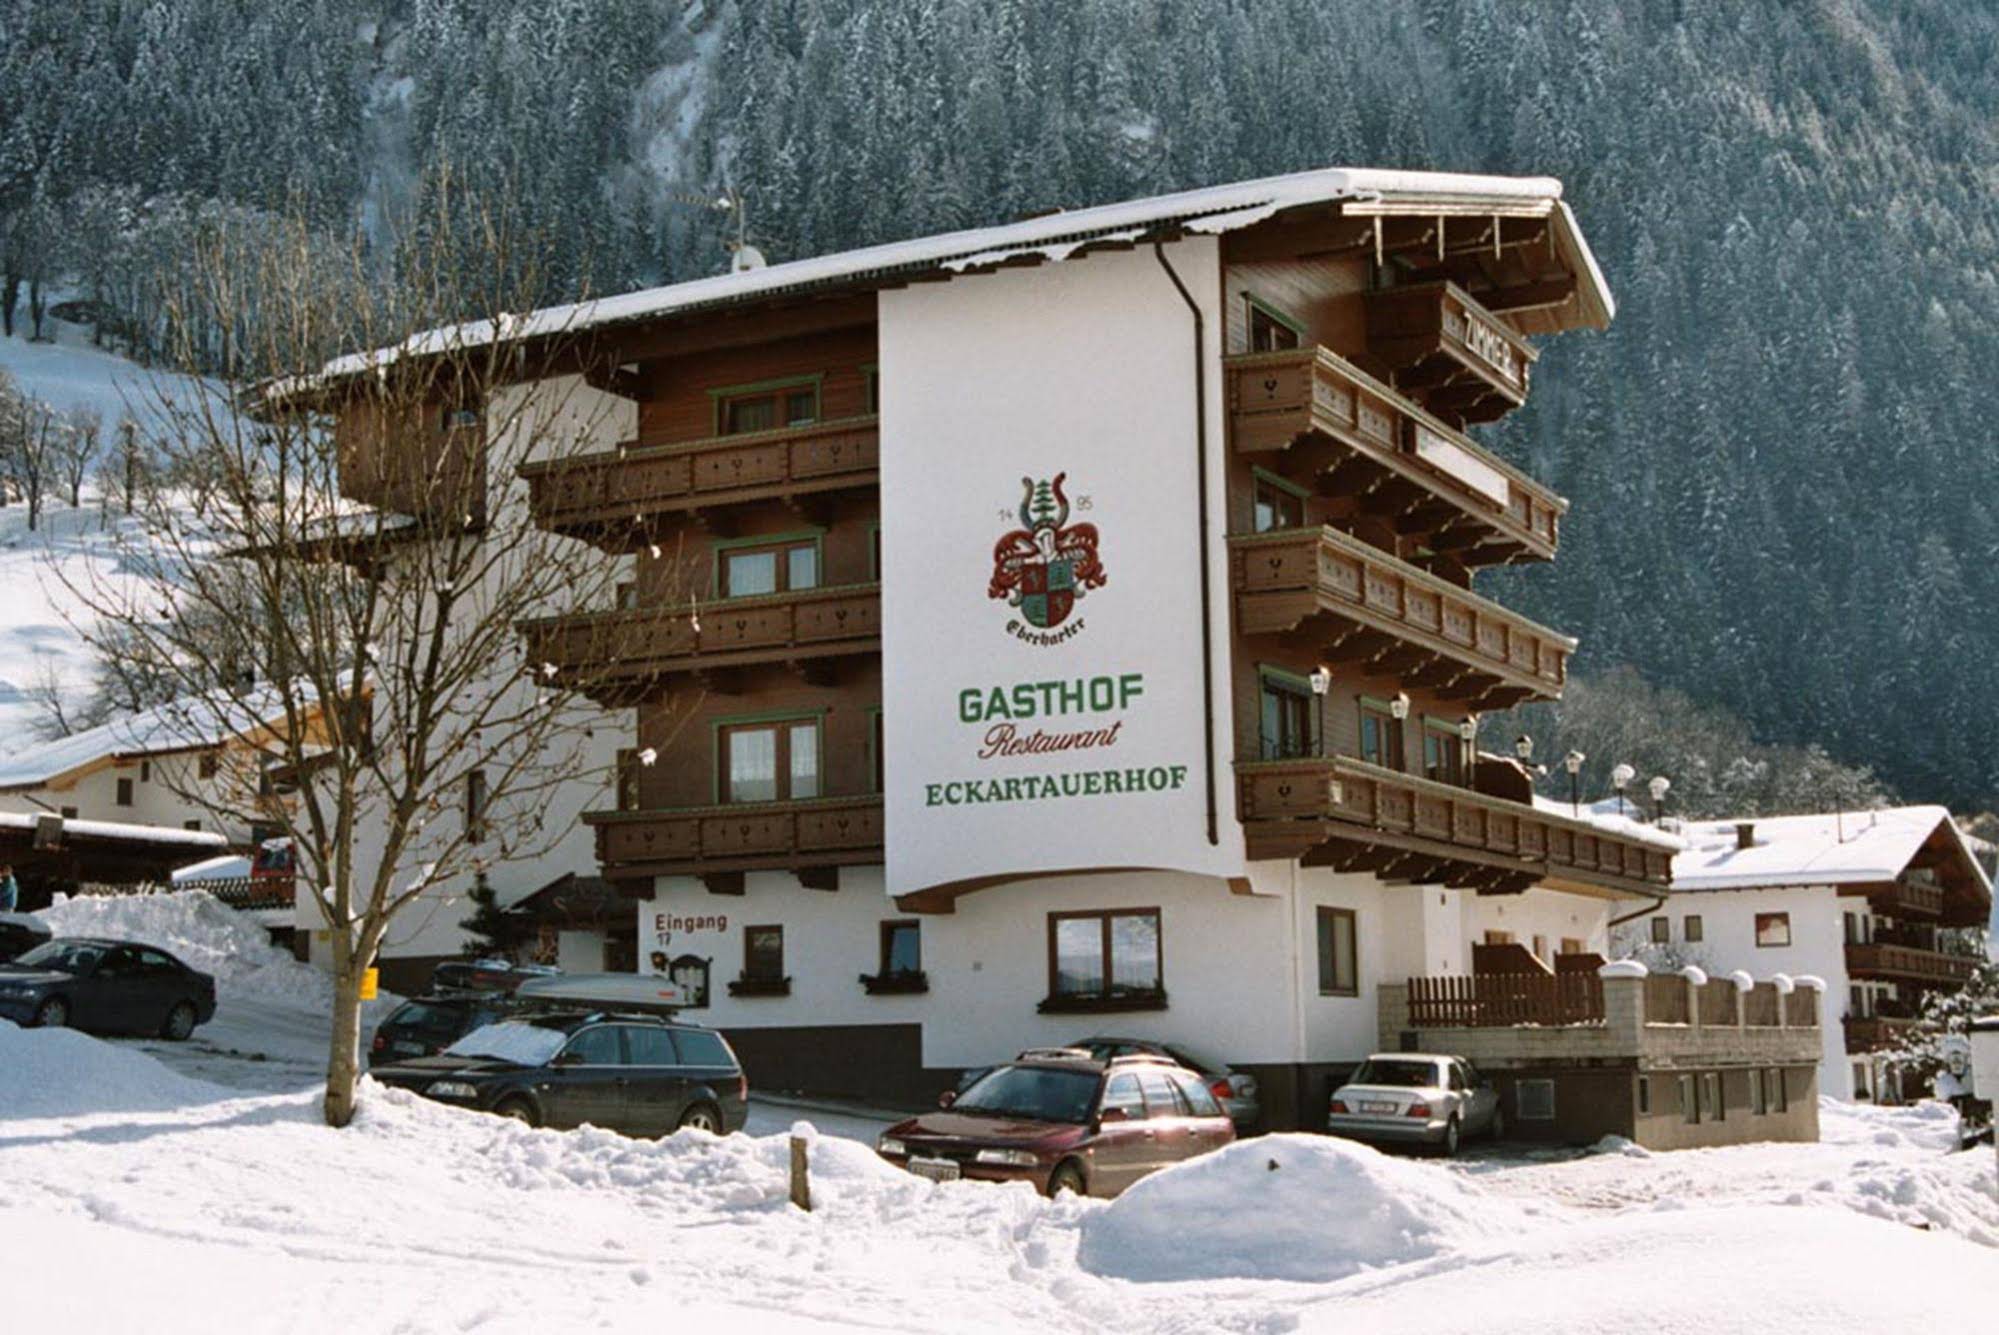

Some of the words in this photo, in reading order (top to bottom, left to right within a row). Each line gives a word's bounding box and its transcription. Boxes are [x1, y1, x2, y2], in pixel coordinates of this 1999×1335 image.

[959, 674, 1143, 723] GASTHOF
[977, 720, 1122, 760] Restaurant
[925, 766, 1188, 806] ECKARTAUERHOF
[655, 913, 728, 934] Eingang
